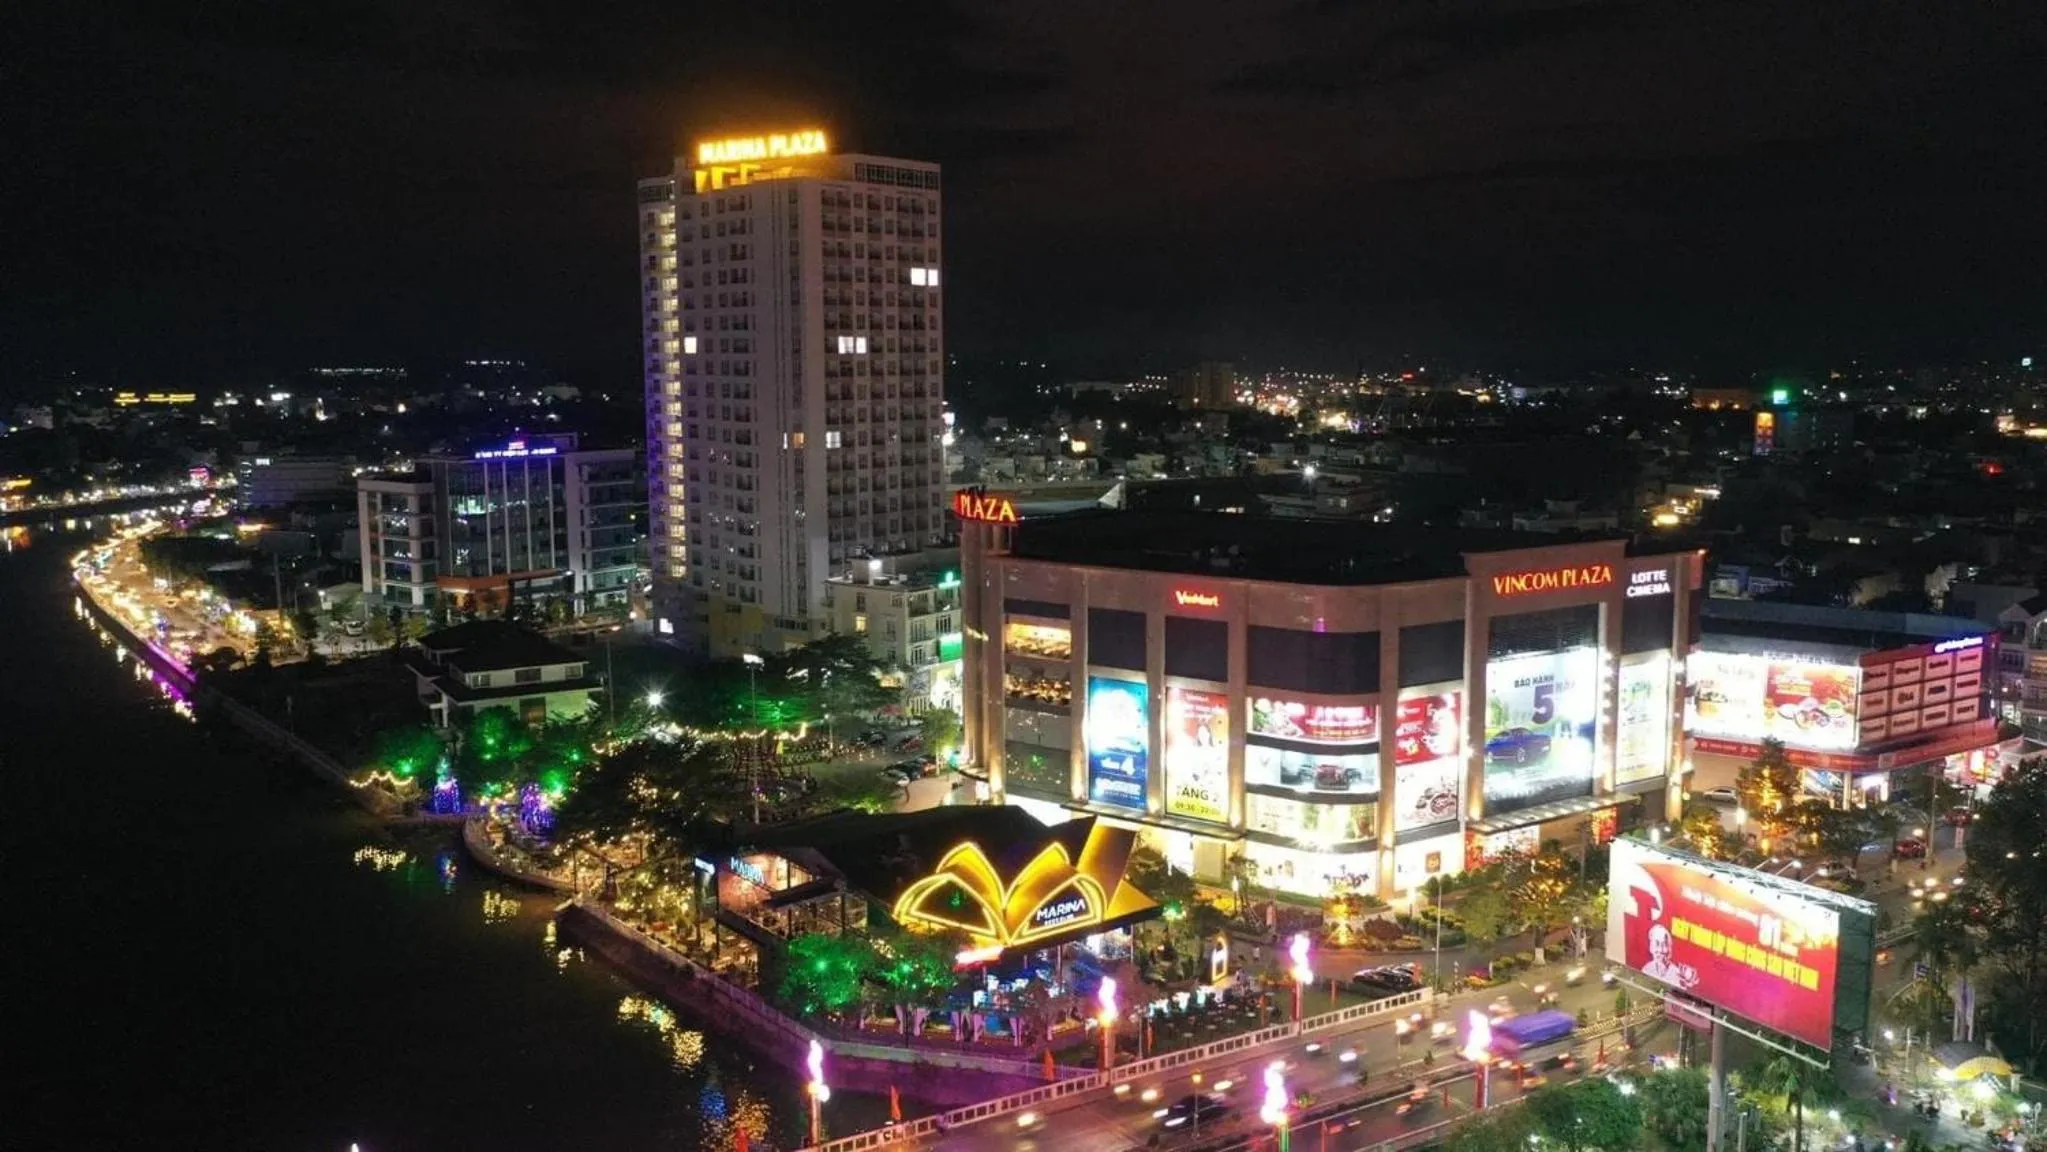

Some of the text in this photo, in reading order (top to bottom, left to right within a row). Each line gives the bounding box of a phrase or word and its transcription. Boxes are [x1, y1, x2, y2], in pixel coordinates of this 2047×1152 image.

[768, 129, 827, 158] PLAZA
[959, 493, 1017, 522] PLAZA
[1494, 565, 1612, 595] VINCOM PLAZA
[1625, 582, 1671, 598] CINEMA
[1631, 569, 1668, 585] LOTTE
[1532, 684, 1554, 725] 5
[1036, 898, 1086, 921] MARINA
